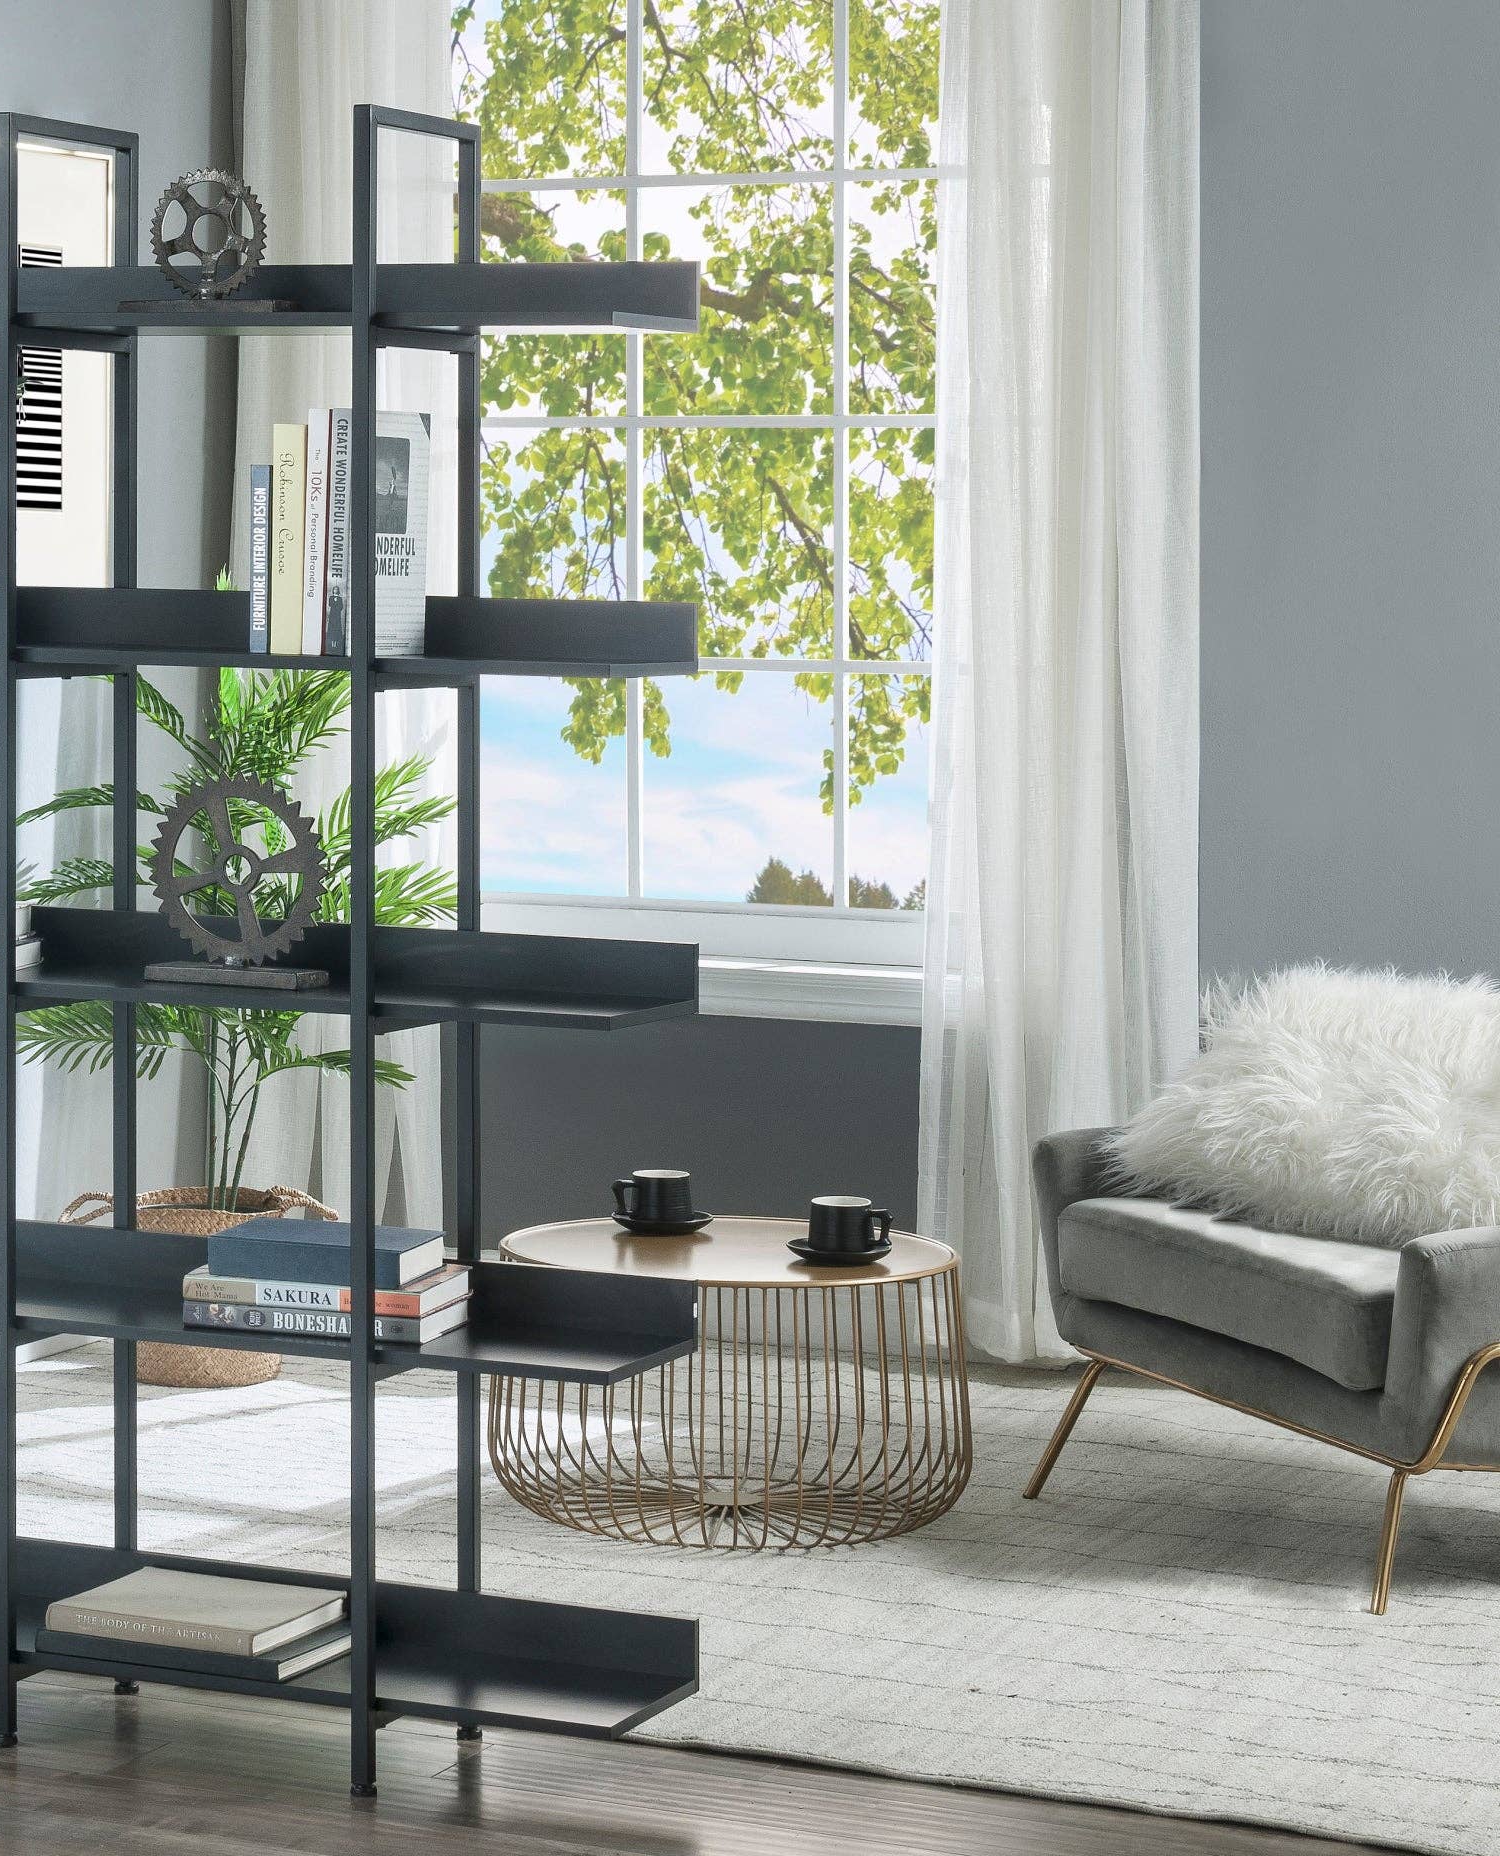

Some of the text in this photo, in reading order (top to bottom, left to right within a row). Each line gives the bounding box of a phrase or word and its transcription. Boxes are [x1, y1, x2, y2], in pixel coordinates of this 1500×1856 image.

[311, 470, 322, 502] 10Ks
[332, 418, 348, 578] CREATE WONDERFUL HOMELIFE
[278, 452, 295, 575] Robinson Crusoe
[310, 513, 319, 553] Personal
[376, 537, 415, 555] NDERFUL
[253, 487, 267, 630] FURNITURE INTERIOR DESIGN
[307, 555, 317, 598] Branding
[263, 1288, 332, 1305] SAKURA
[272, 1312, 384, 1337] BONESHAR
[75, 1614, 97, 1624] THE
[101, 1617, 130, 1629] BODY
[133, 1621, 147, 1632] OF
